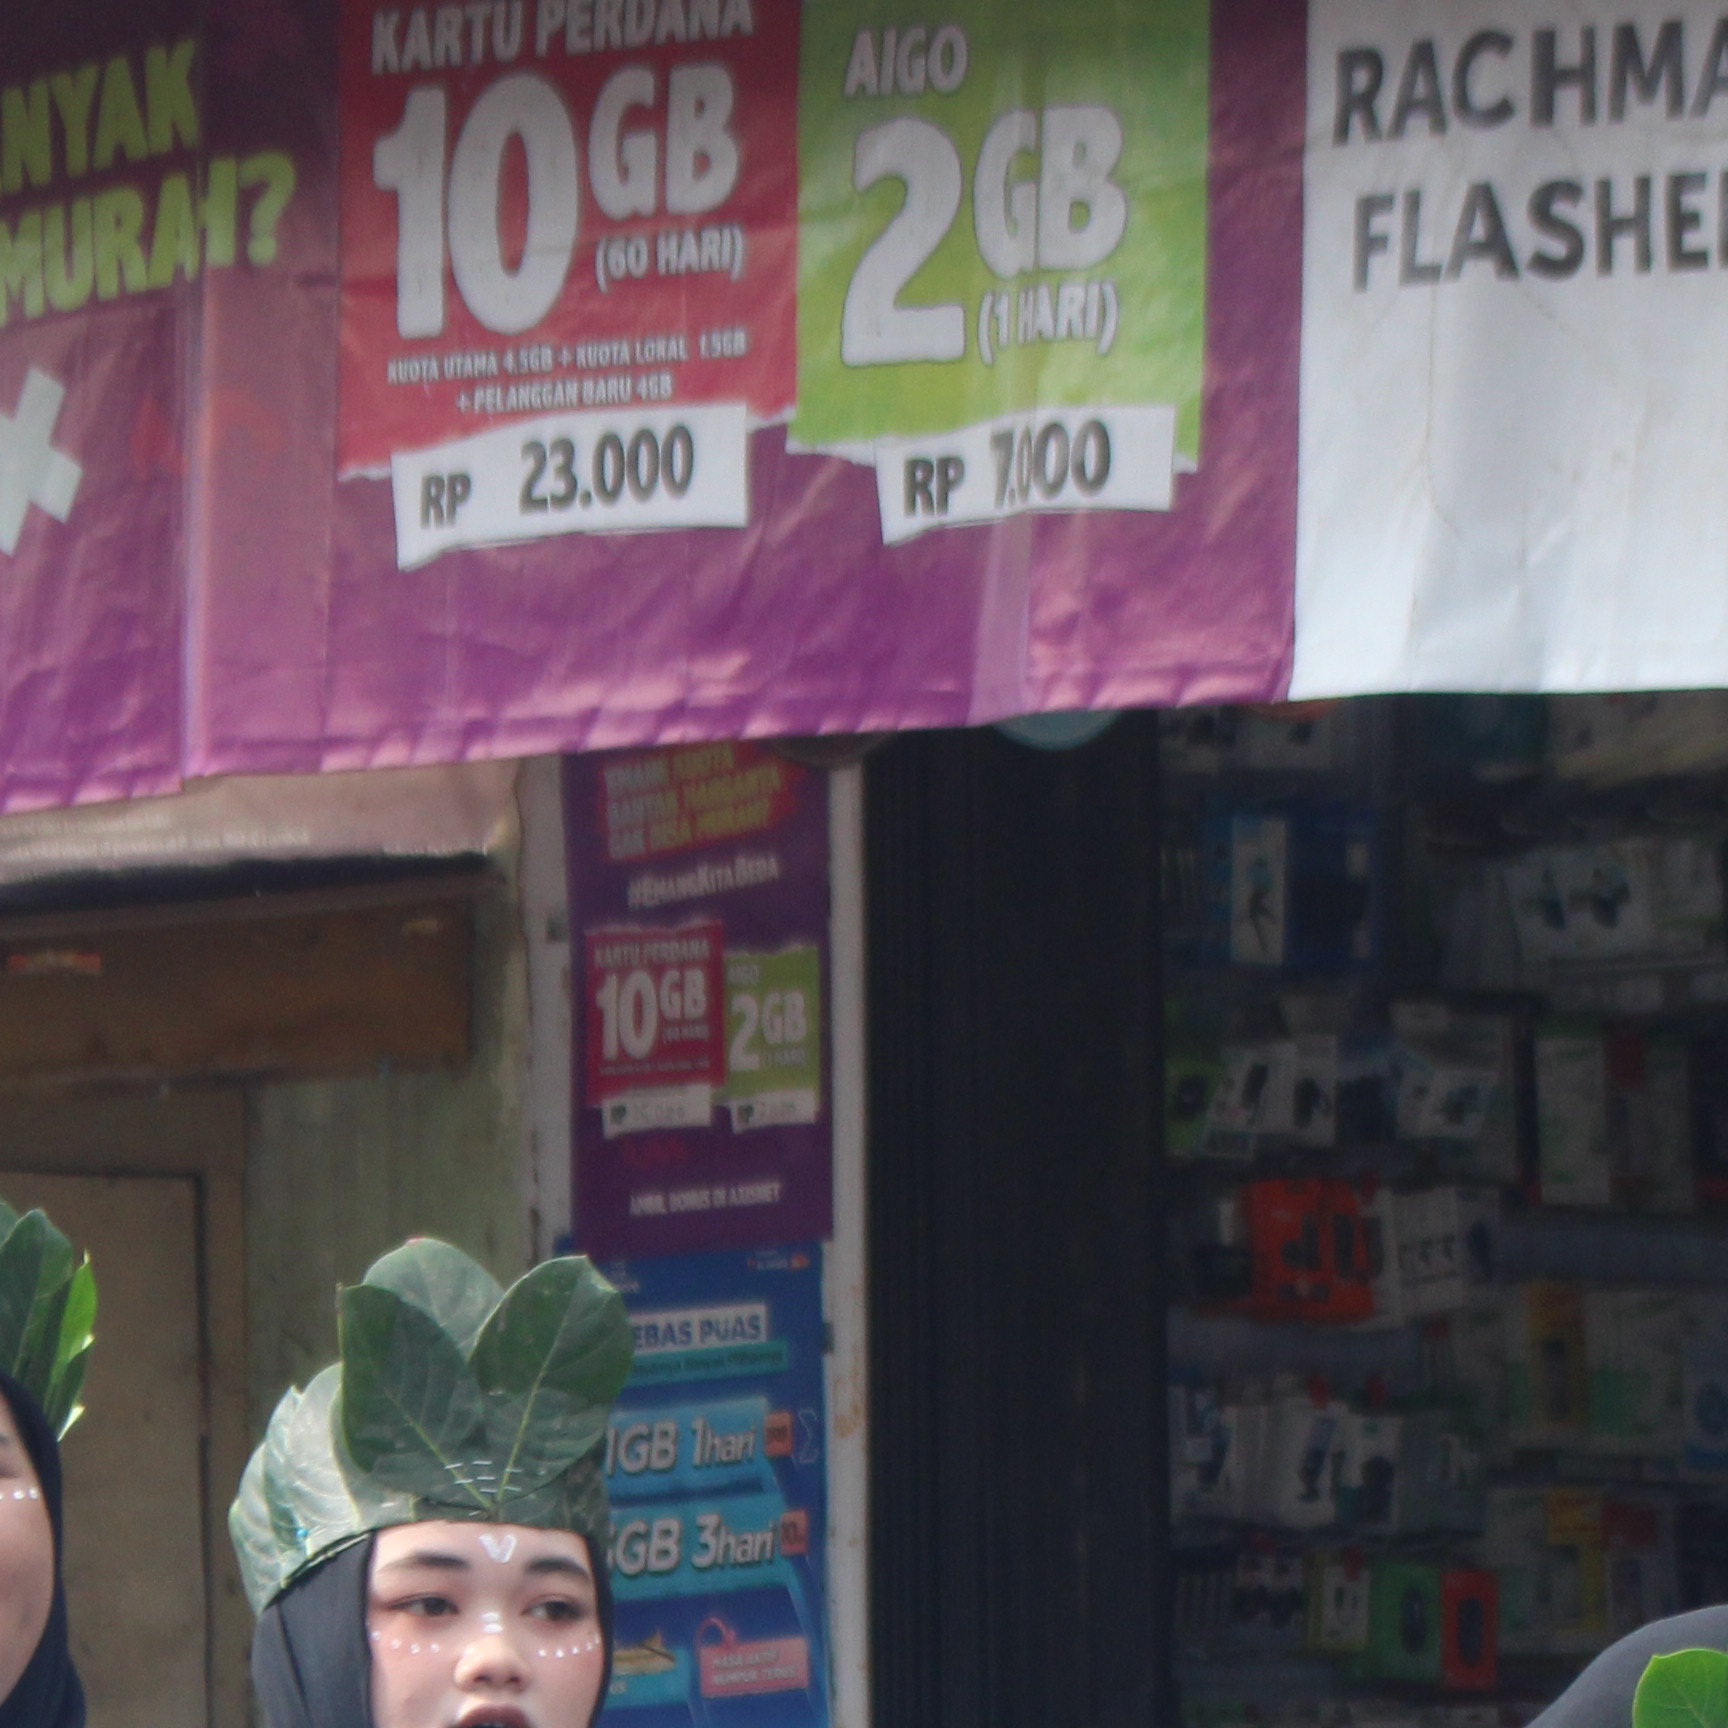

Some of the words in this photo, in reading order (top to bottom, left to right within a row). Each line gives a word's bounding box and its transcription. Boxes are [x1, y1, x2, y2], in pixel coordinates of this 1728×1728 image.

[372, 0, 524, 76] KARTU
[534, 0, 756, 58] PERDANA
[842, 23, 970, 98] AIGO
[595, 232, 649, 294] (60
[656, 222, 746, 283] HARI)
[1016, 279, 1120, 358] HARI)
[387, 356, 440, 385] KUOTA
[443, 349, 499, 380] UTAMA
[575, 338, 631, 369] KUOTA
[634, 333, 690, 364] LOKAL
[473, 377, 580, 415] PELANGGAN
[581, 373, 633, 404] BARU
[419, 472, 472, 531] RP
[517, 422, 695, 518] 23.000
[902, 454, 966, 519] RP
[699, 1314, 761, 1344] PUAS
